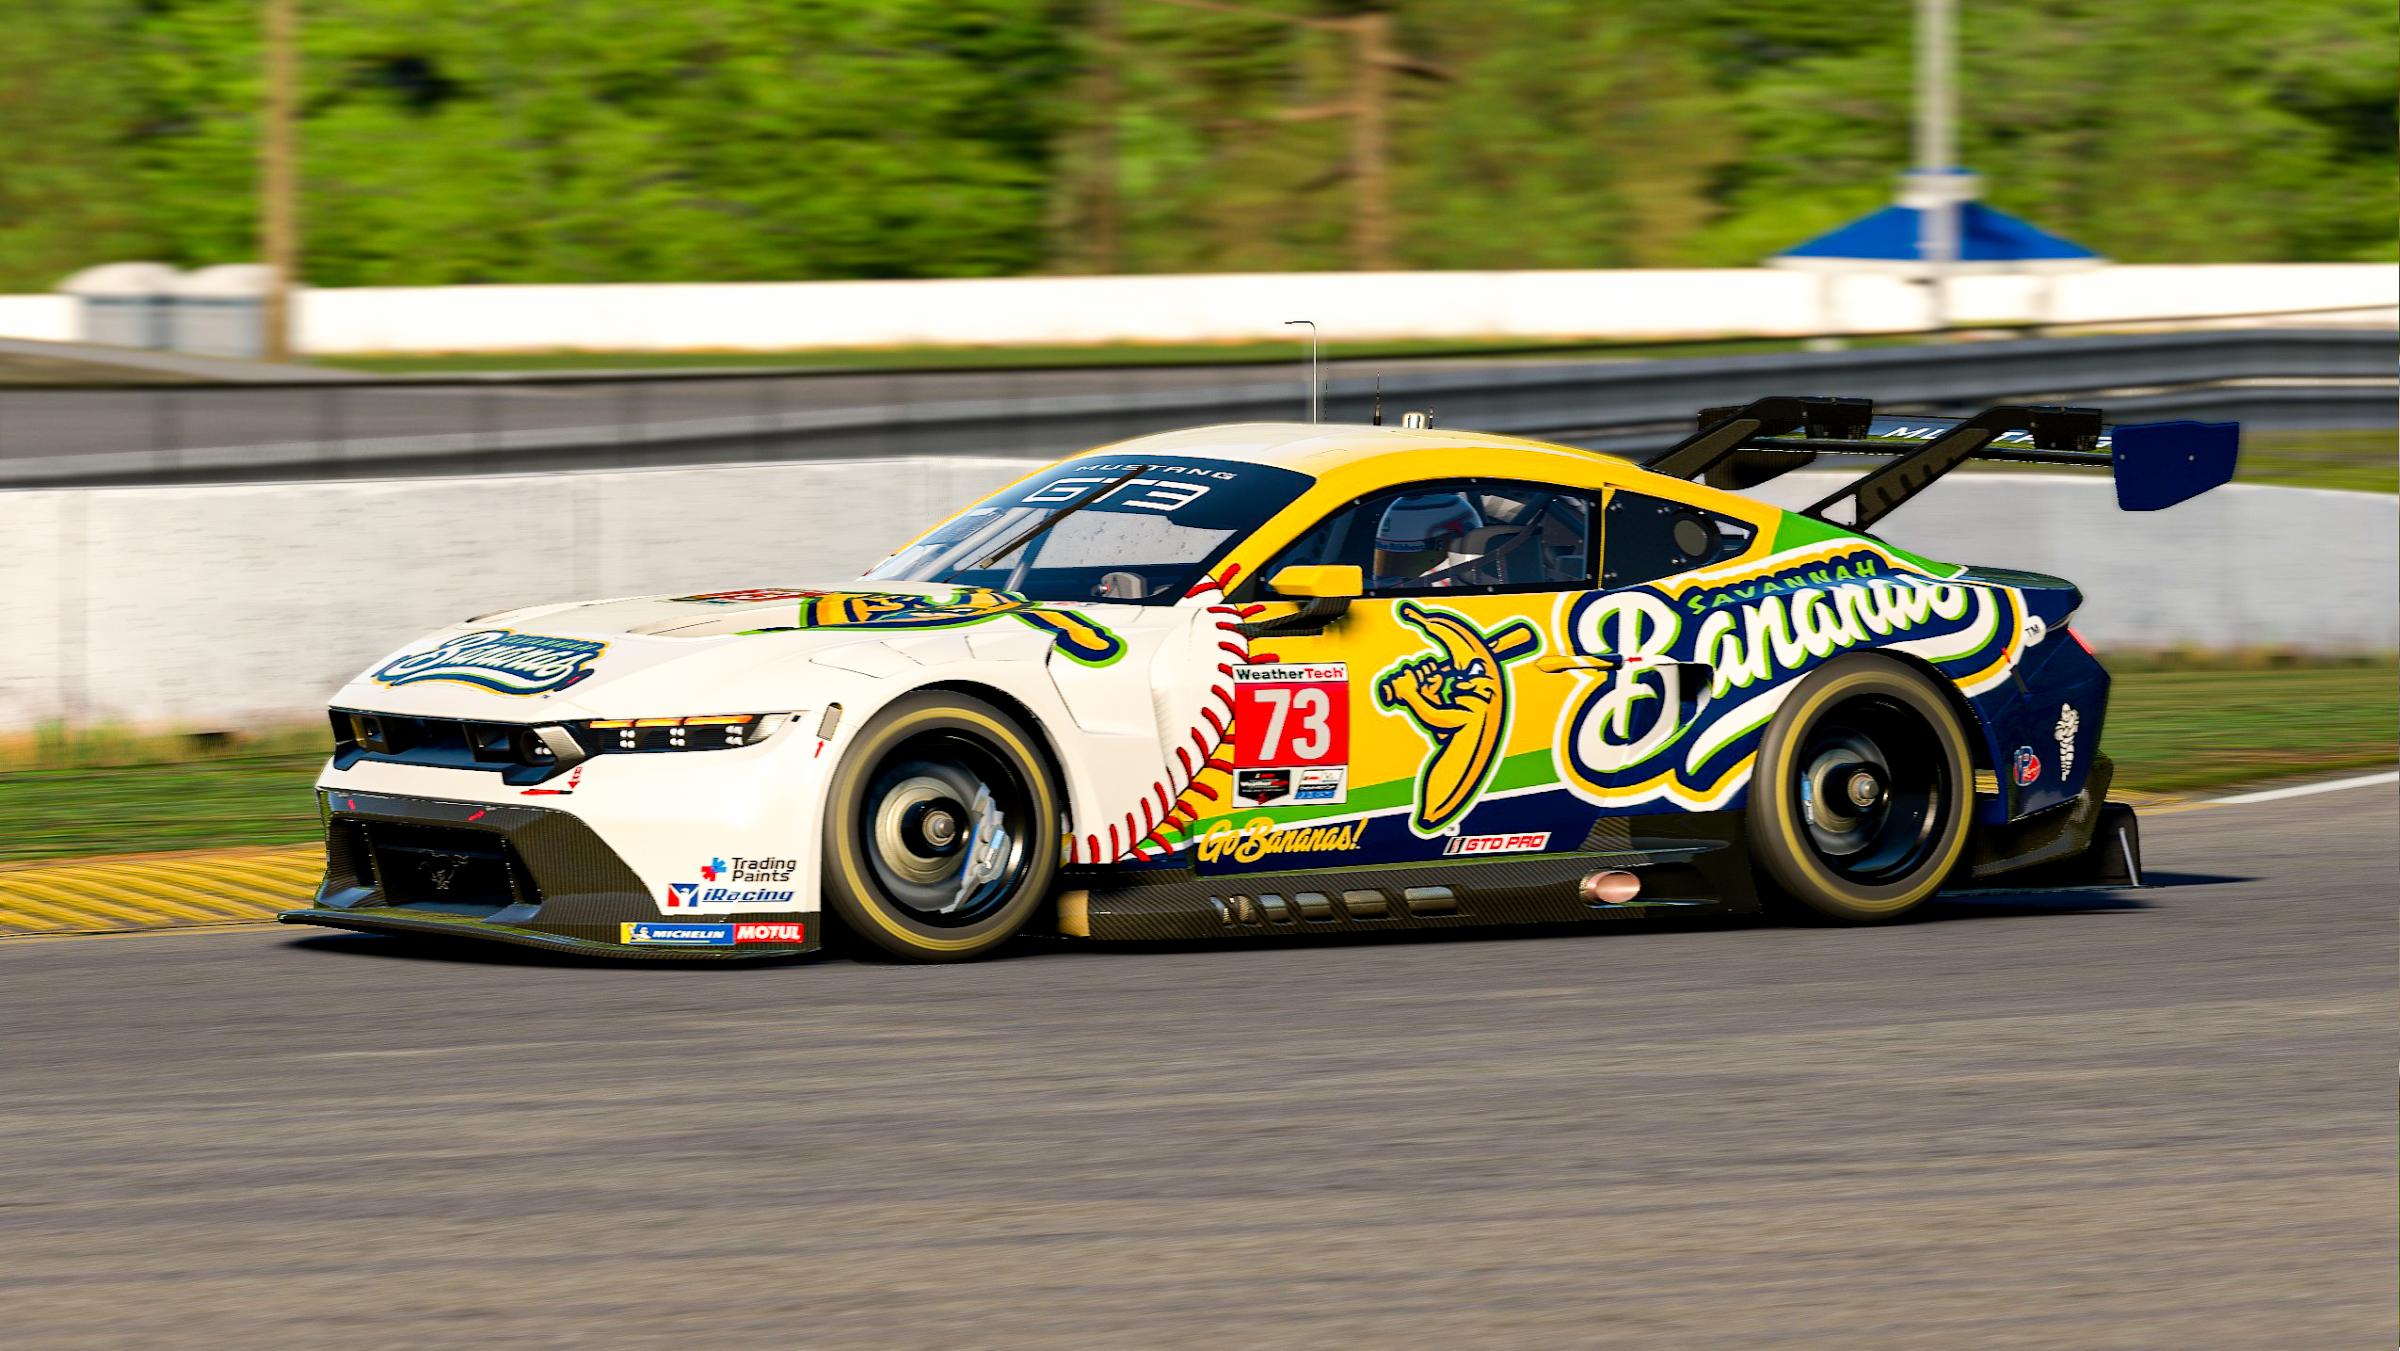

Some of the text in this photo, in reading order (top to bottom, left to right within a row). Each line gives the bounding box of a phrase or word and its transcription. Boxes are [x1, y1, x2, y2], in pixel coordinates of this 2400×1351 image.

[1074, 464, 1237, 480] MUSTANG
[1021, 477, 1211, 511] GT3
[1686, 559, 1877, 615] SAVANNAH
[1236, 668, 1343, 680] WeatherTech
[1577, 575, 1999, 775] Bananas
[1254, 687, 1331, 761] 73
[1197, 816, 1368, 864] Go Bananas!
[1465, 837, 1503, 851] GTD
[1506, 835, 1545, 849] PRO
[731, 857, 797, 872] Trading
[732, 870, 790, 882] Paints
[702, 888, 796, 902] iRacing
[653, 930, 725, 939] MICHELIN
[737, 925, 801, 940] MOTUL
